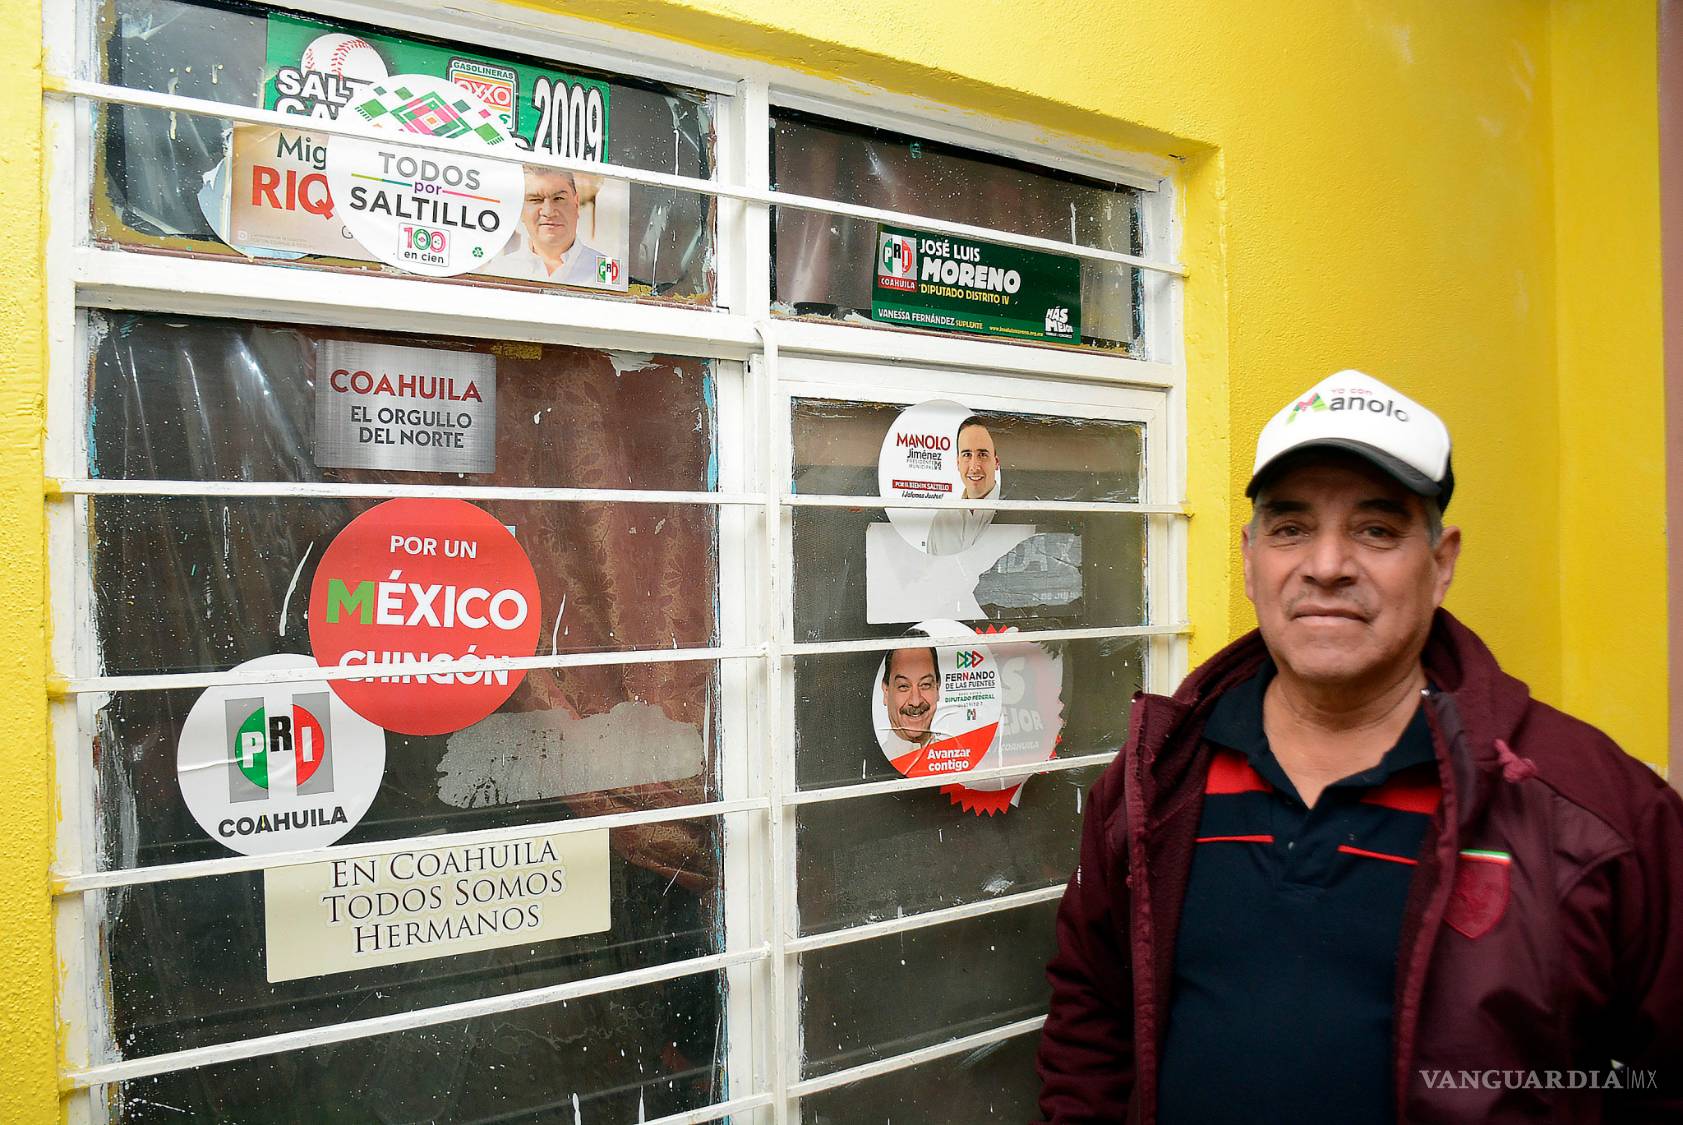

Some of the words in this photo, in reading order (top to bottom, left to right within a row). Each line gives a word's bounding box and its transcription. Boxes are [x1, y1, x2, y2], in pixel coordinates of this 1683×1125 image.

[453, 61, 514, 79] GASOLINERAS
[533, 77, 604, 163] 2009
[378, 151, 481, 191] TODOS
[414, 181, 443, 195] por
[350, 186, 500, 233] SALTILLO
[403, 227, 447, 253] 100
[920, 238, 950, 258] JOSÉ
[953, 244, 980, 262] LUIS
[404, 250, 418, 261] en
[421, 252, 445, 264] cien
[884, 243, 909, 268] PRI
[881, 277, 916, 290] COAHUILA
[921, 257, 1021, 294] MORENO
[921, 284, 964, 299] DIPUTADO
[965, 290, 1000, 304] DISTRITO
[1001, 295, 1010, 305] IV
[878, 308, 911, 321] VANESSA
[912, 312, 955, 326] FERNÁNDEZ
[955, 319, 984, 330] SUPLENTE
[330, 369, 483, 403] COAHUILA
[351, 405, 372, 423] EL
[377, 407, 472, 429] ORGULLO
[359, 427, 395, 445] DEL
[400, 429, 464, 448] NORTE
[896, 432, 951, 451] MANOLO
[906, 448, 942, 461] Jiménez
[389, 535, 437, 556] POR
[444, 540, 478, 559] UN
[326, 569, 528, 630] MÉXICO
[338, 644, 510, 686] CHINGÓN
[945, 671, 995, 682] FERNANDO
[944, 695, 971, 703] DIPUTADO
[241, 715, 314, 768] PRI
[927, 748, 971, 760] Avanzar
[928, 759, 970, 772] contigo
[218, 806, 348, 838] COAHUILA
[332, 860, 377, 889] EN
[389, 839, 558, 881] COAHUILA
[322, 885, 443, 923] TODOS
[455, 869, 563, 907] SOMOS
[354, 904, 540, 954] HERMANOS
